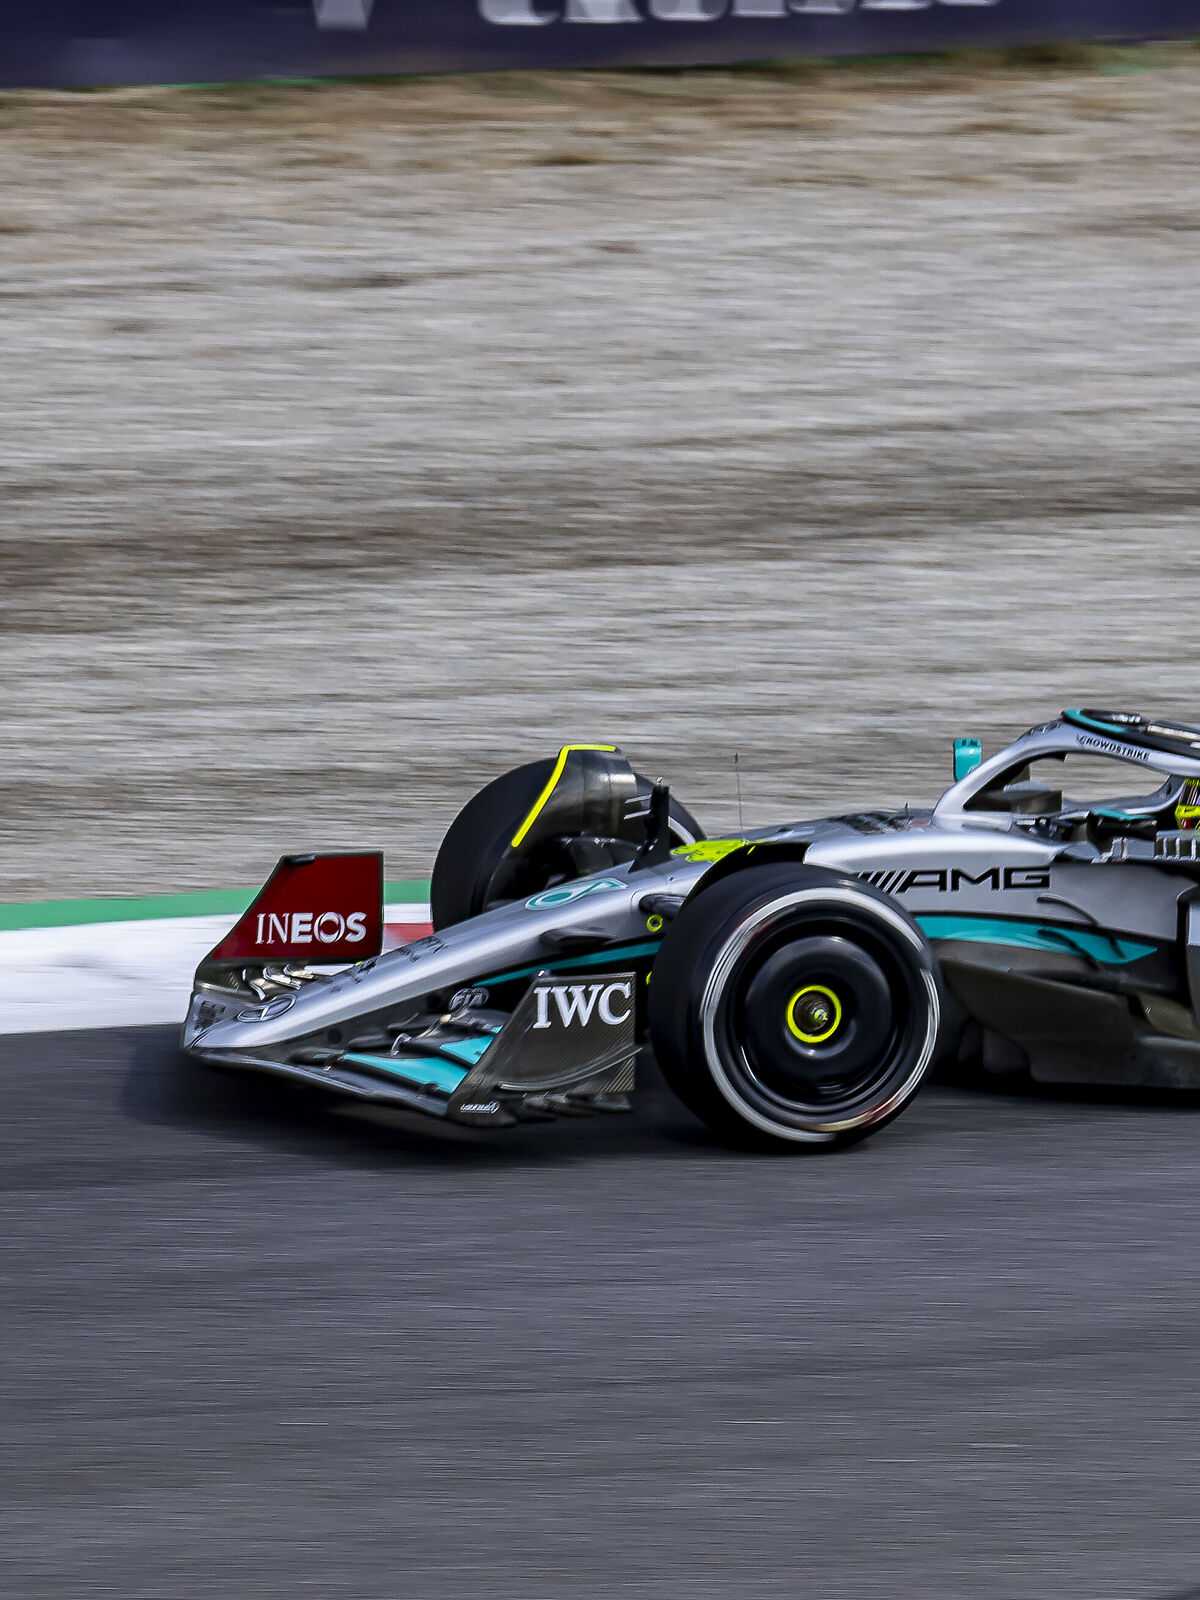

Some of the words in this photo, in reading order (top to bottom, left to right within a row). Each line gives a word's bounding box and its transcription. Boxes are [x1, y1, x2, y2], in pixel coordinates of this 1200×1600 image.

[896, 867, 1050, 894] AMG
[255, 911, 367, 944] INEOS
[533, 982, 631, 1029] IWC
